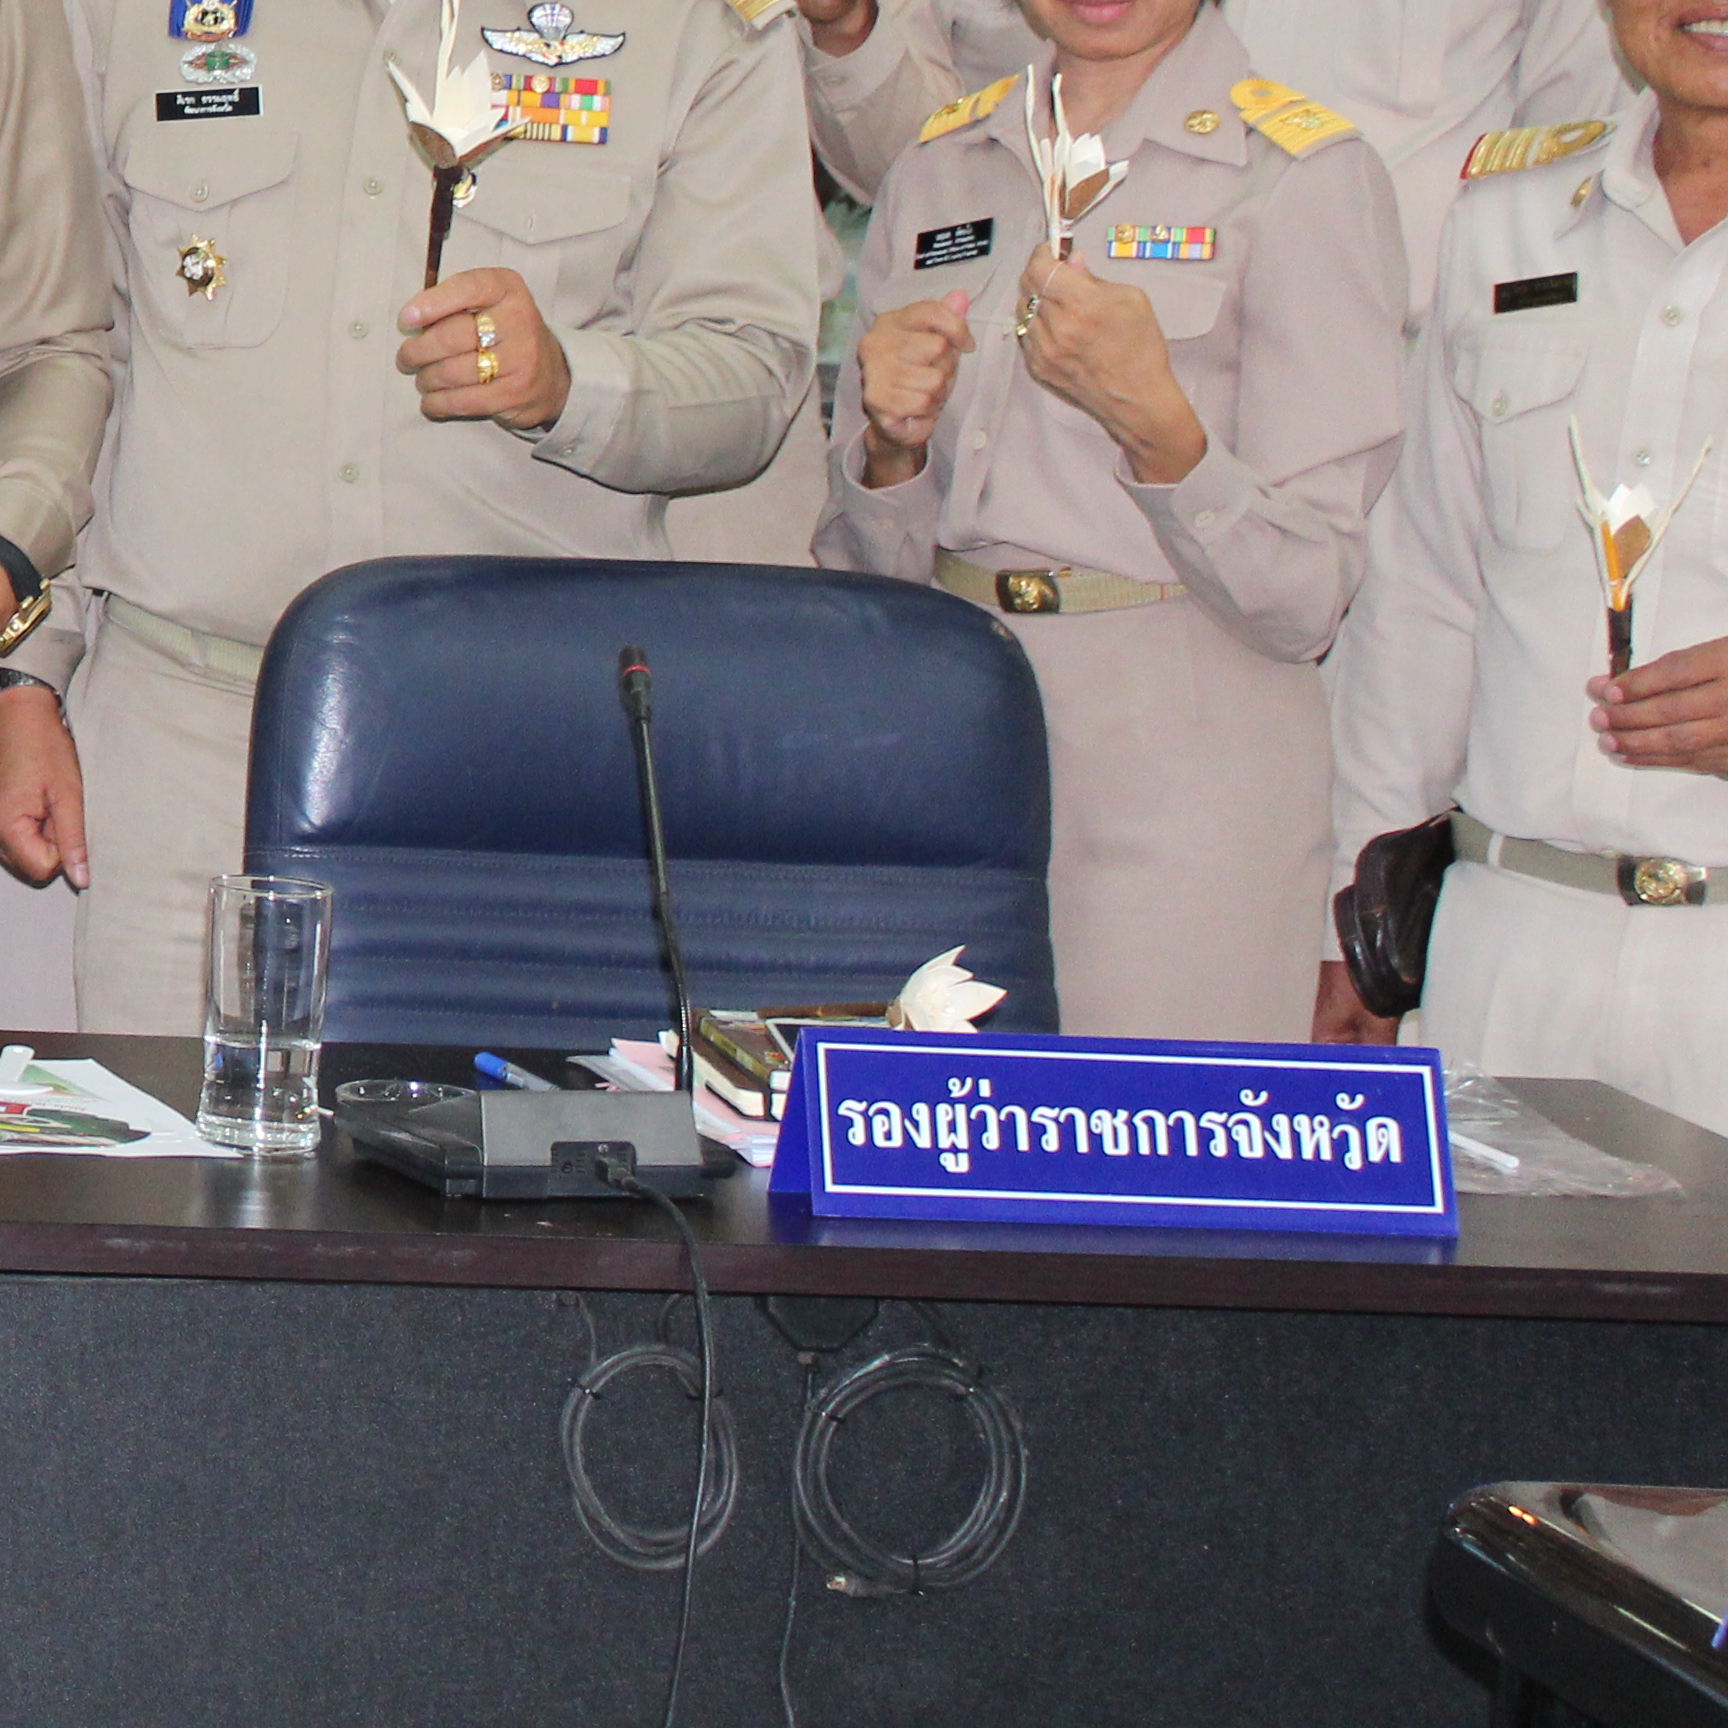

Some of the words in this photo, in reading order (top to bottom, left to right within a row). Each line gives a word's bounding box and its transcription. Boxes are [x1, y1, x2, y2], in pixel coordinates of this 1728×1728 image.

[838, 1077, 1402, 1173] รองผู้ว่าราชการจังหวัด
